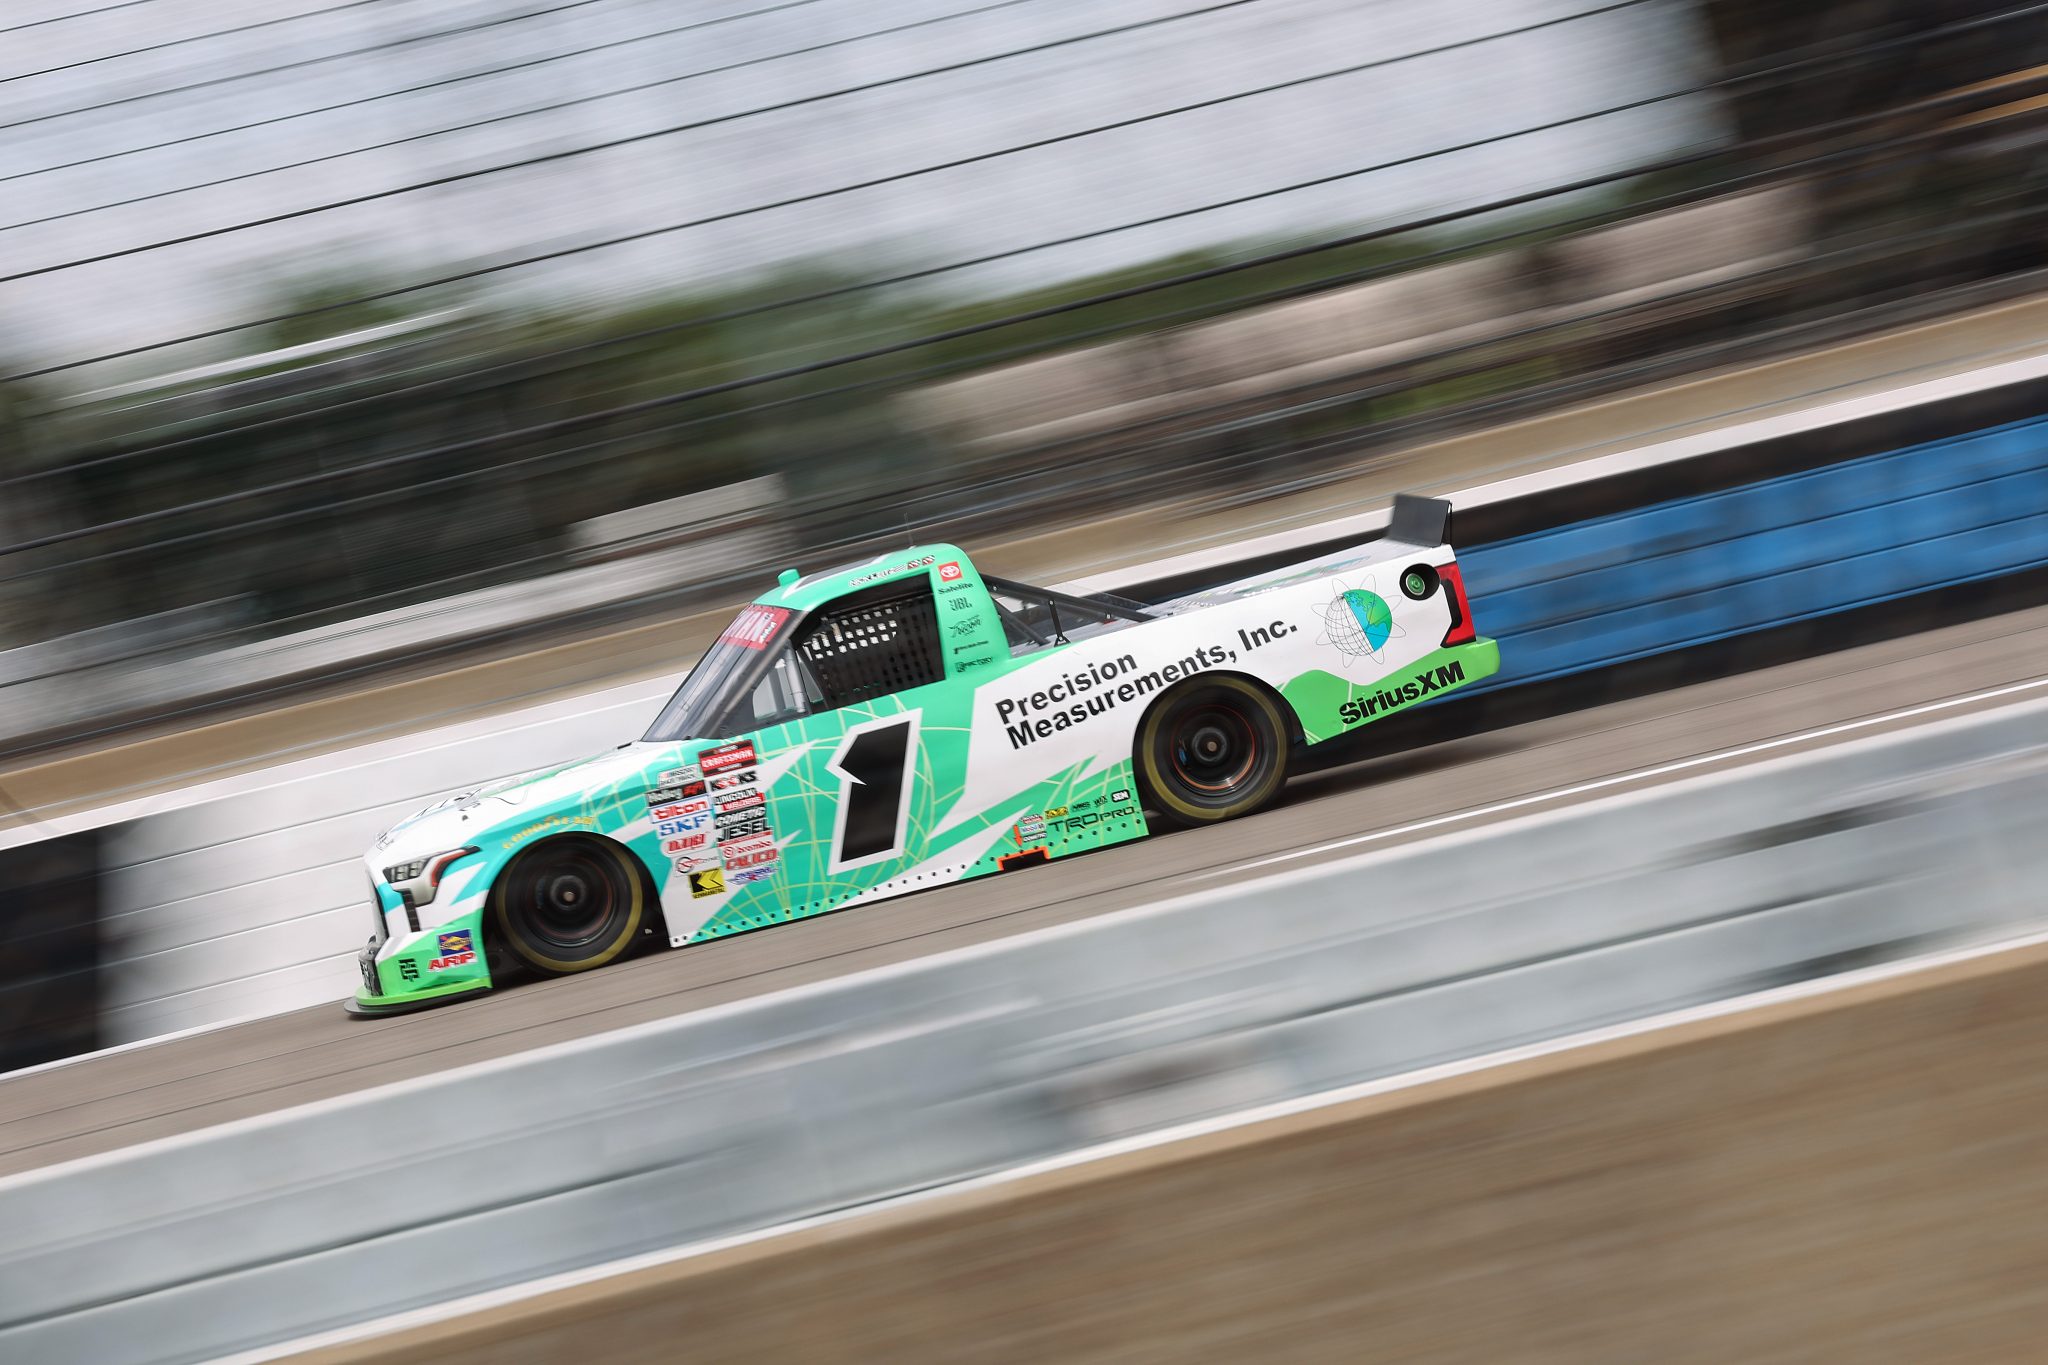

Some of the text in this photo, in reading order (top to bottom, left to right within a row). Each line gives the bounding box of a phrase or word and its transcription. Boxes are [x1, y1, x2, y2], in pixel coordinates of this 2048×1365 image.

[950, 597, 972, 611] JBL
[995, 653, 1138, 725] Precision
[1006, 619, 1298, 750] Measurements, Inc.
[1339, 660, 1466, 725] SiriusXM
[701, 749, 754, 768] CRAFTSMAN
[833, 714, 916, 868] 1
[660, 814, 709, 837] SKF
[716, 806, 766, 827] COMETIC
[717, 818, 769, 842] JESEL
[428, 951, 477, 971] ARP
